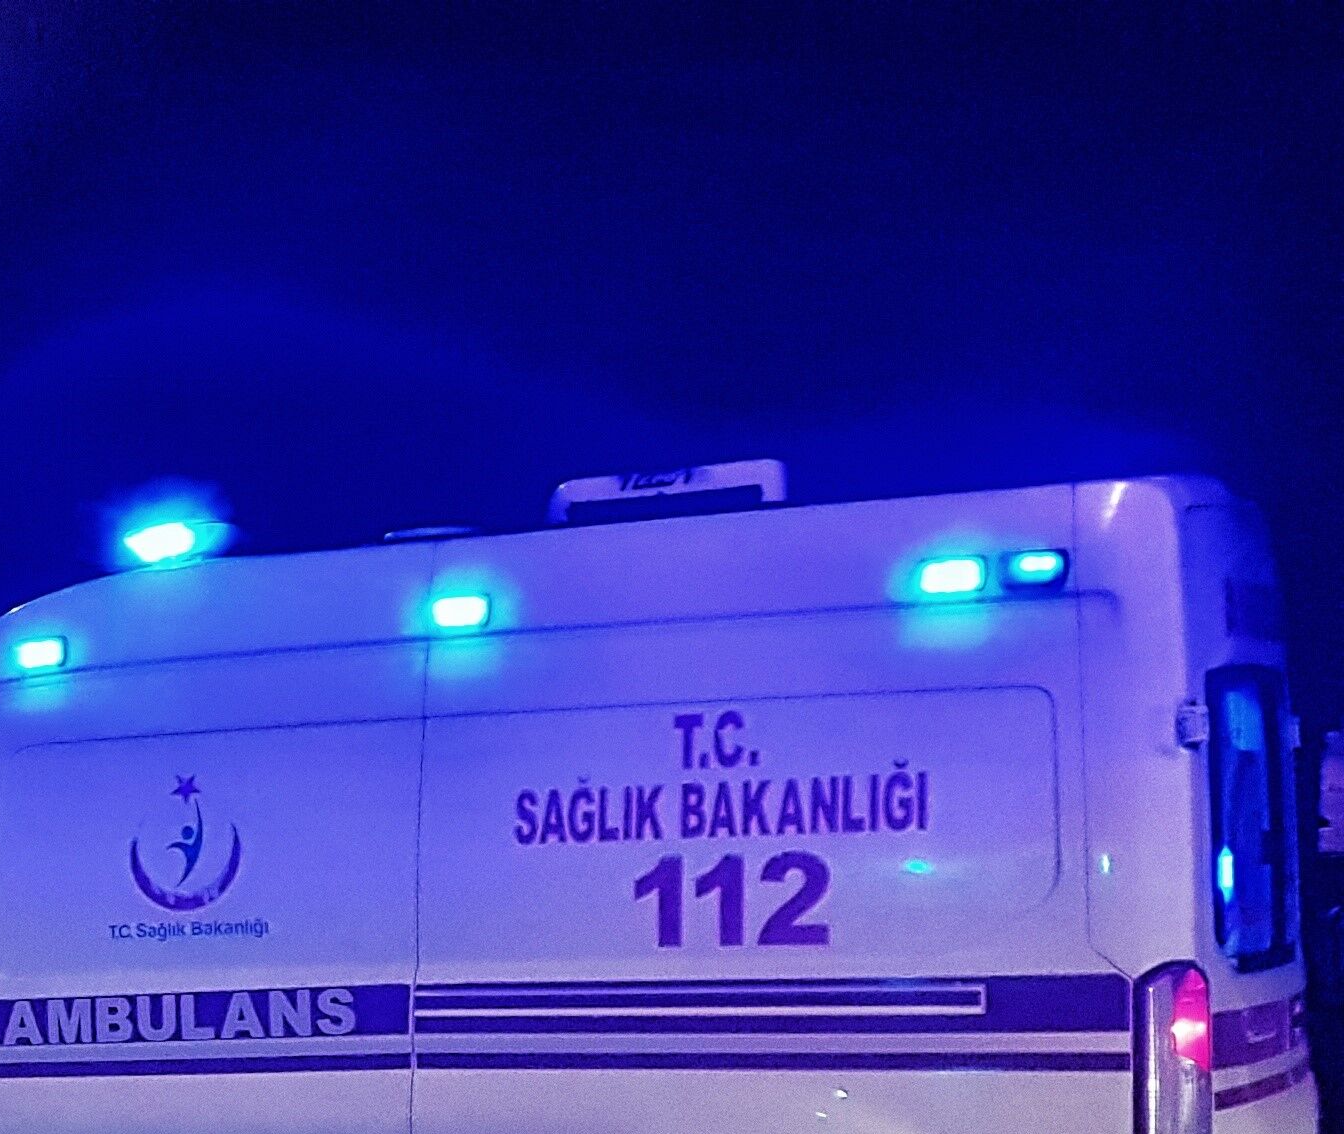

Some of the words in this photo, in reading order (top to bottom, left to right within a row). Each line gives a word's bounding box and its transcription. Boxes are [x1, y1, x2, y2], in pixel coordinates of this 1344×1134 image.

[673, 709, 760, 769] T.C.
[514, 775, 664, 845] SAĞLIK
[680, 758, 928, 840] BAKANLIĞI
[633, 849, 831, 948] 112
[135, 922, 187, 942] Sağlık
[191, 918, 270, 939] Bakanlığı
[3, 988, 357, 1046] AMBULANS
